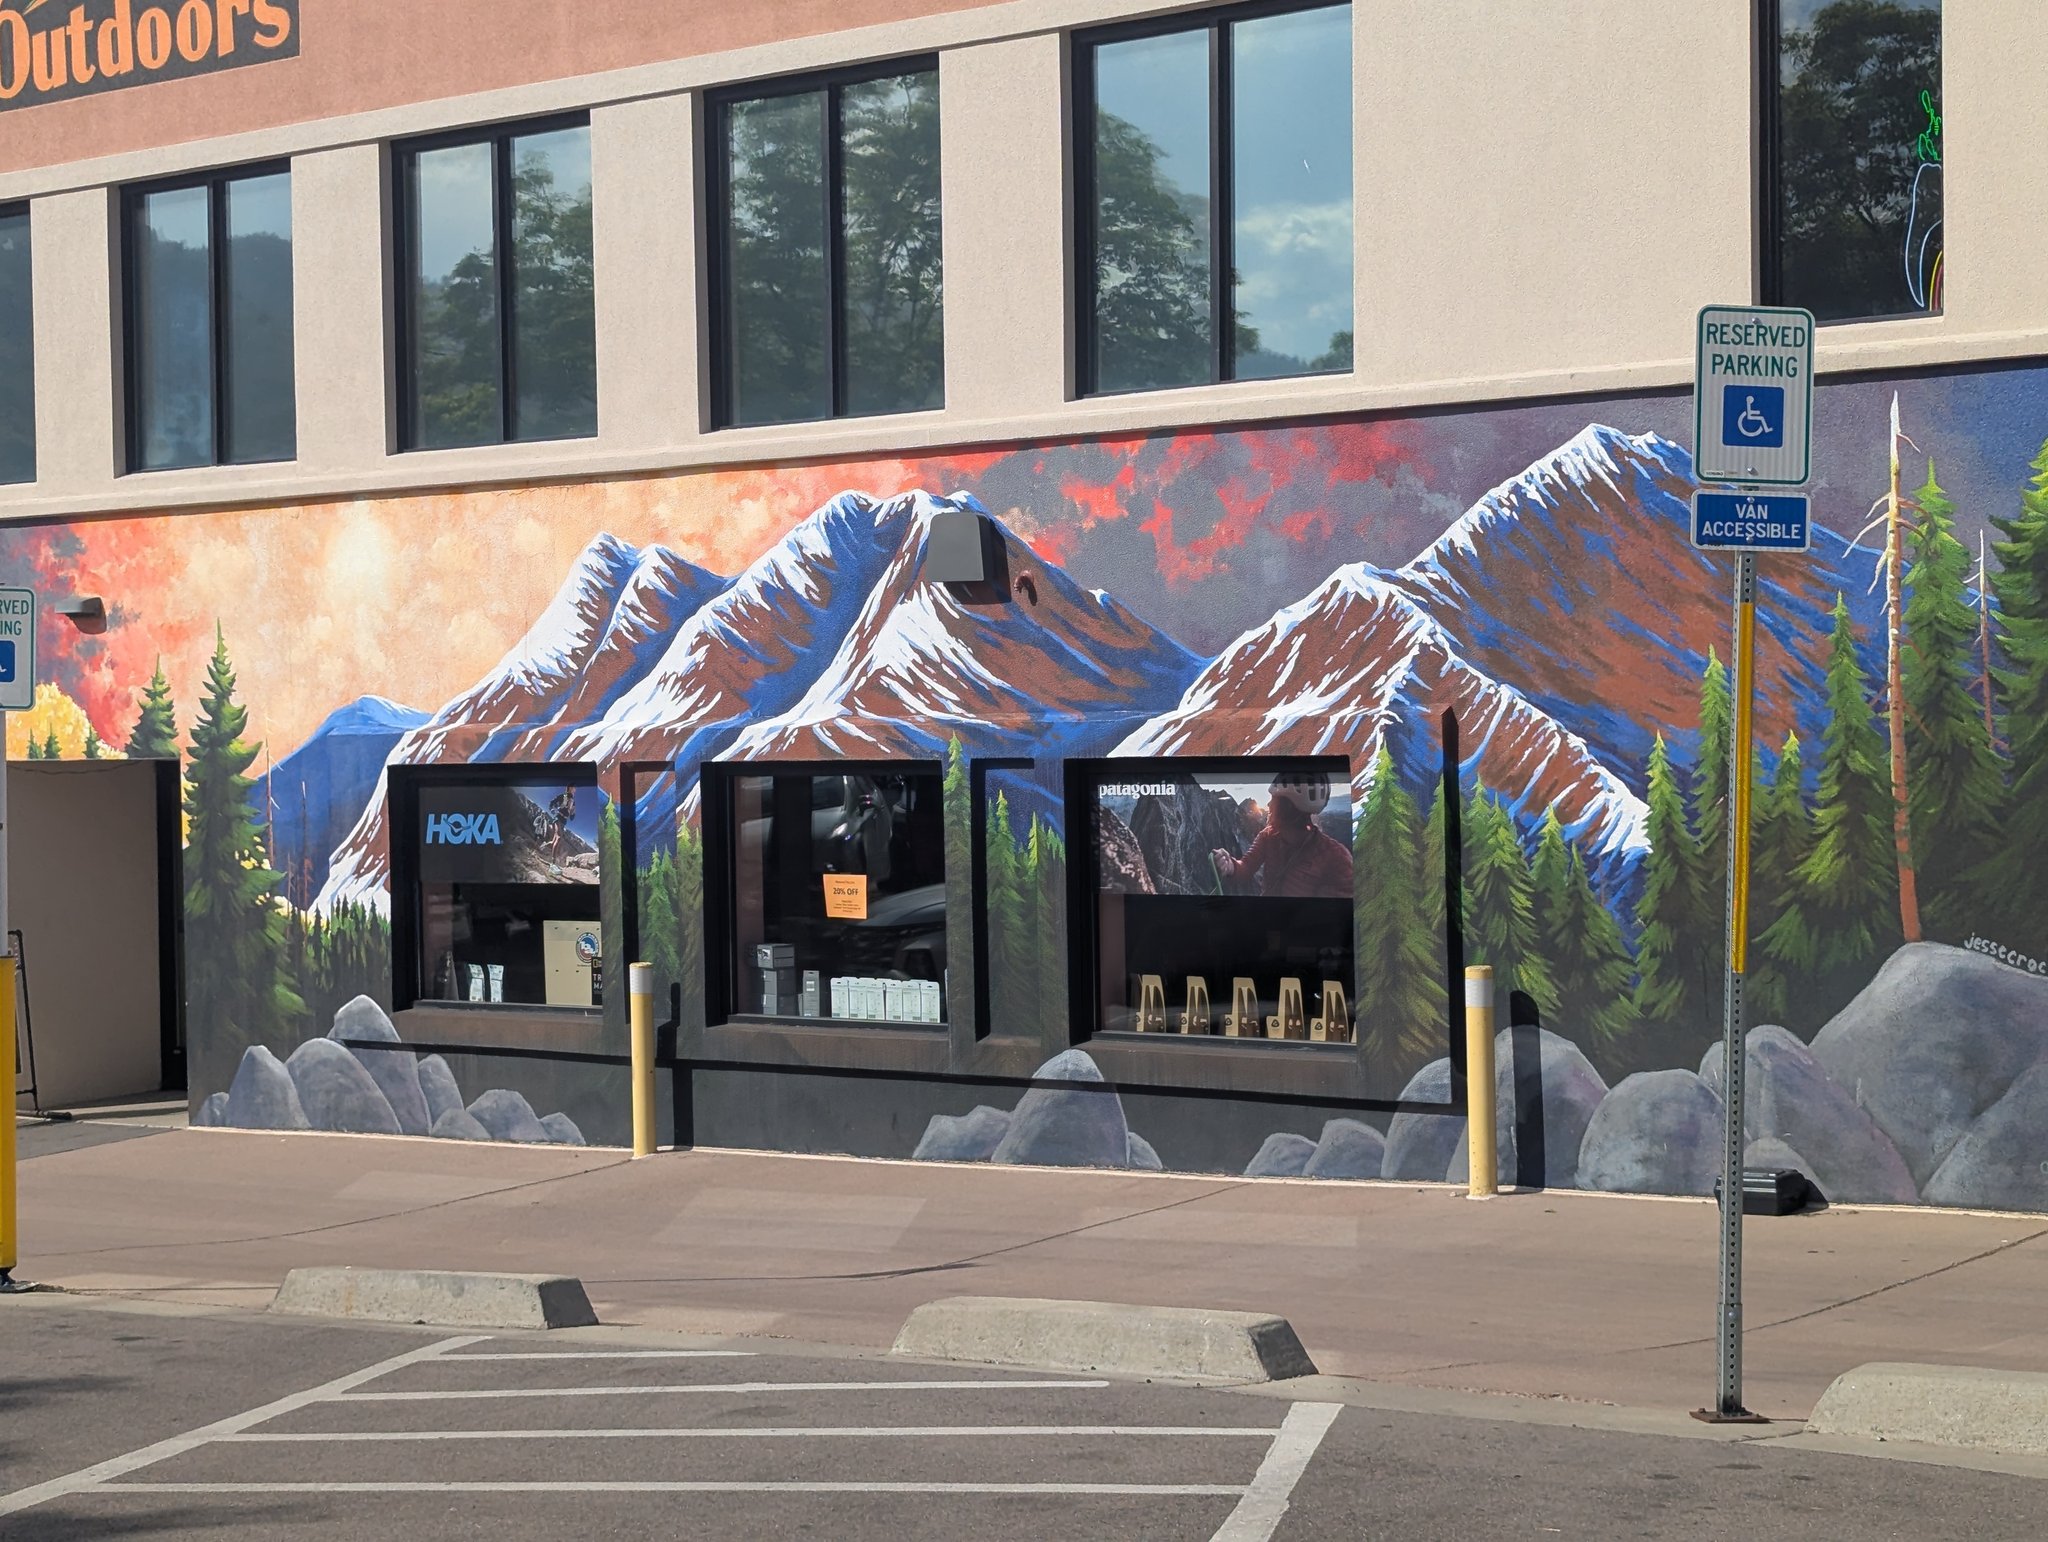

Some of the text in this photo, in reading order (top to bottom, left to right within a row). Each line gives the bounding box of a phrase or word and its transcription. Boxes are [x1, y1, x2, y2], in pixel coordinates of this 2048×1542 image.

[0, 0, 290, 98] Outdoors
[1706, 323, 1805, 348] RESERVED
[1712, 353, 1798, 378] PARKING
[1735, 503, 1768, 520] VAN
[1701, 520, 1801, 539] ACCESSIBLE
[1099, 780, 1176, 799] patagonia
[425, 813, 501, 845] HOKA
[833, 887, 859, 896] 20% OFF
[1963, 932, 2048, 974] jessecroc
